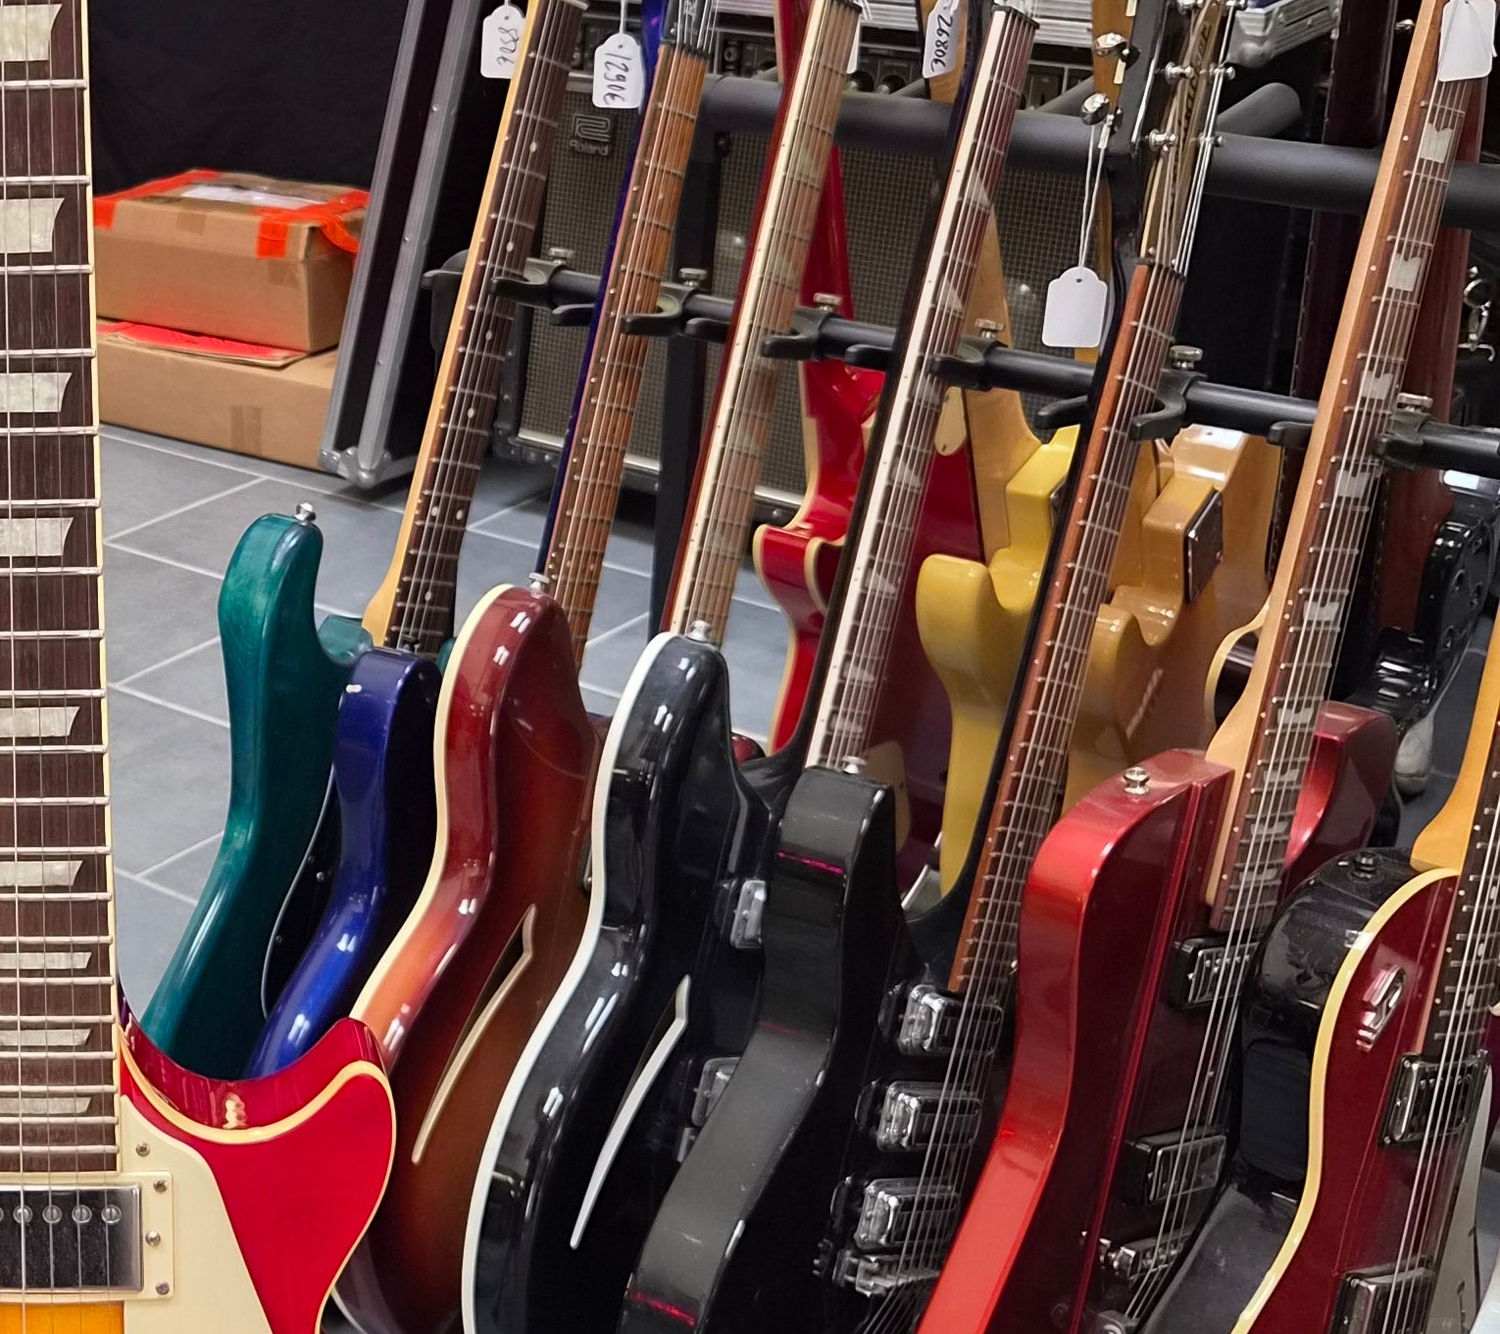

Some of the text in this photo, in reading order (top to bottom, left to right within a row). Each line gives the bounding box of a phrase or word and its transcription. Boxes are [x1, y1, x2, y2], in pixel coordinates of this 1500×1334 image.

[930, 14, 954, 73] 2680€
[603, 52, 633, 105] 1290€
[570, 139, 609, 156] Roland
